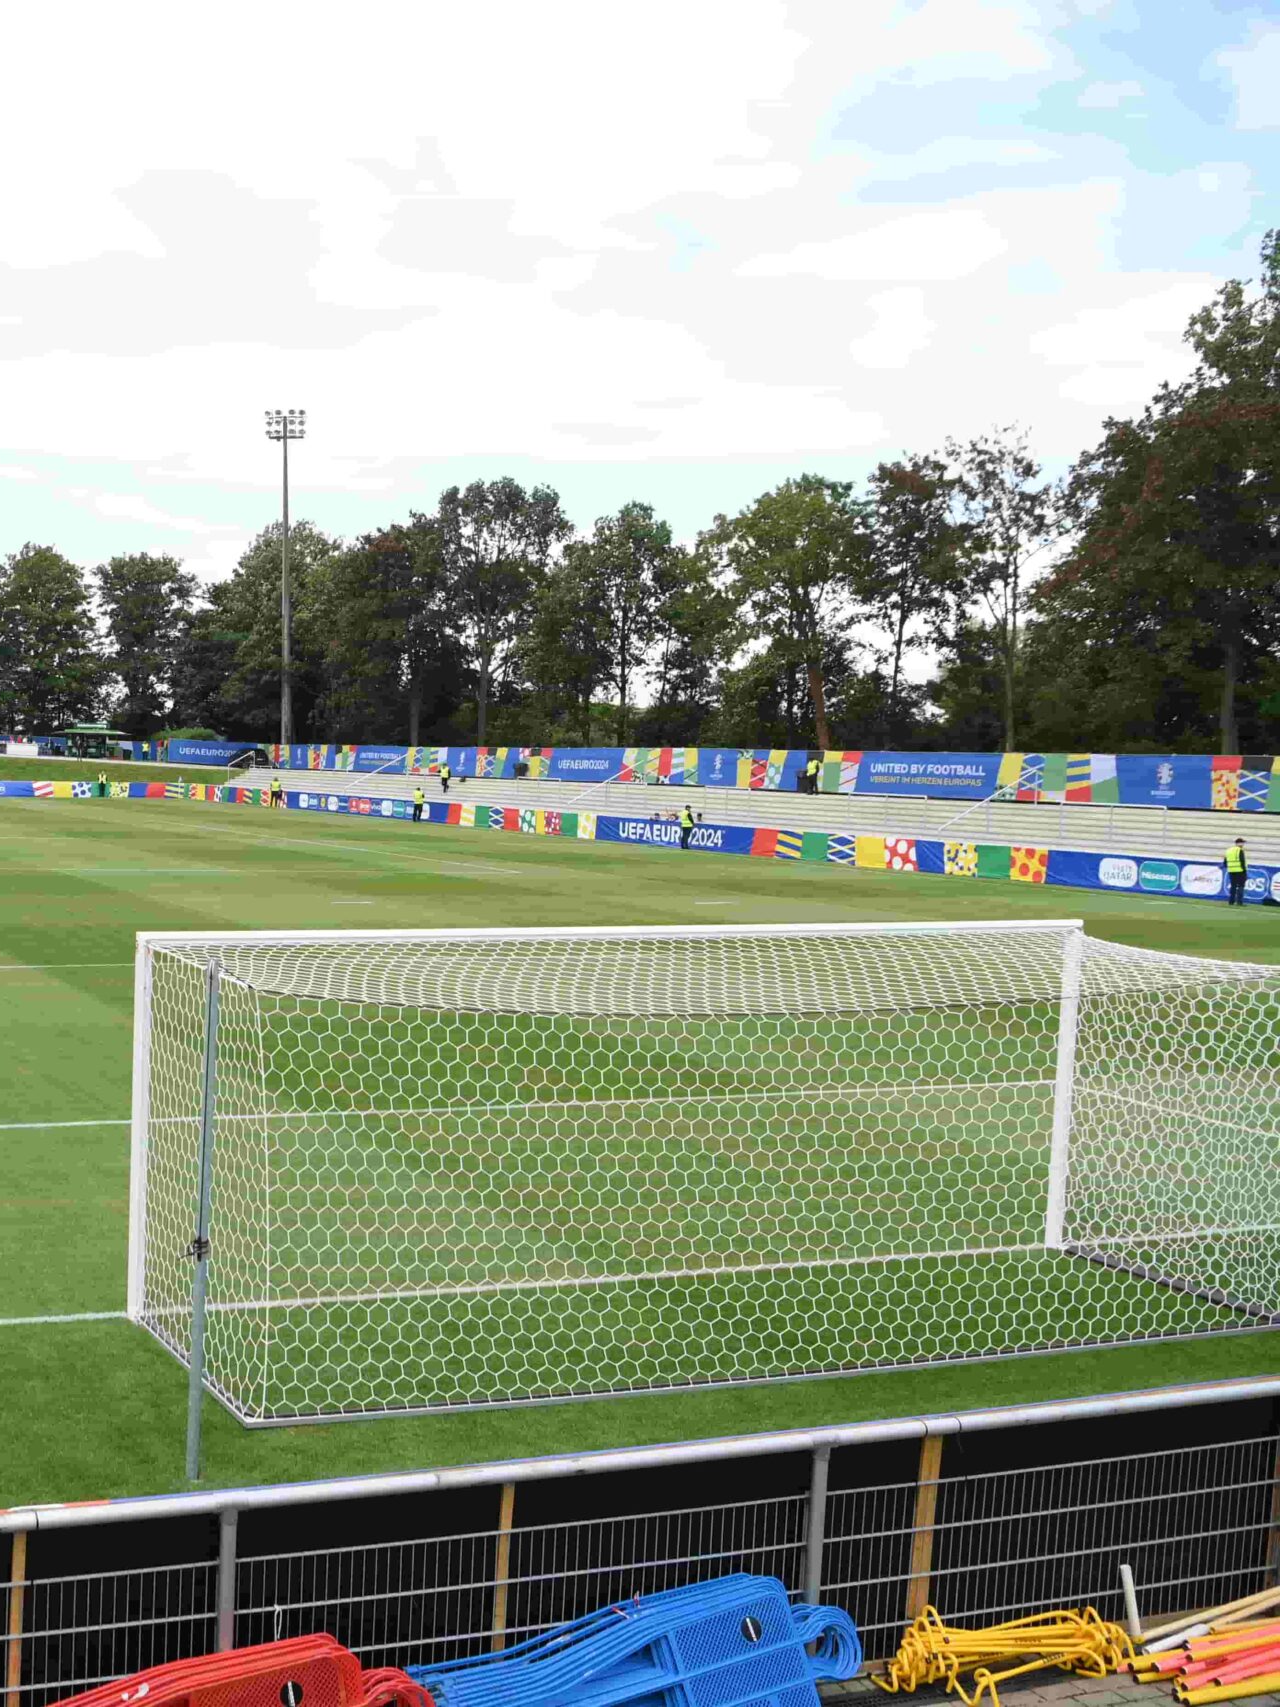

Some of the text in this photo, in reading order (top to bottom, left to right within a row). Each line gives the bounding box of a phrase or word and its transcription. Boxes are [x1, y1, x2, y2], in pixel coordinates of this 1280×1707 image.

[870, 762, 986, 776] UNITED BY FOOTBALL
[943, 777, 982, 787] EUROPAS
[1141, 871, 1177, 882] Hisense
